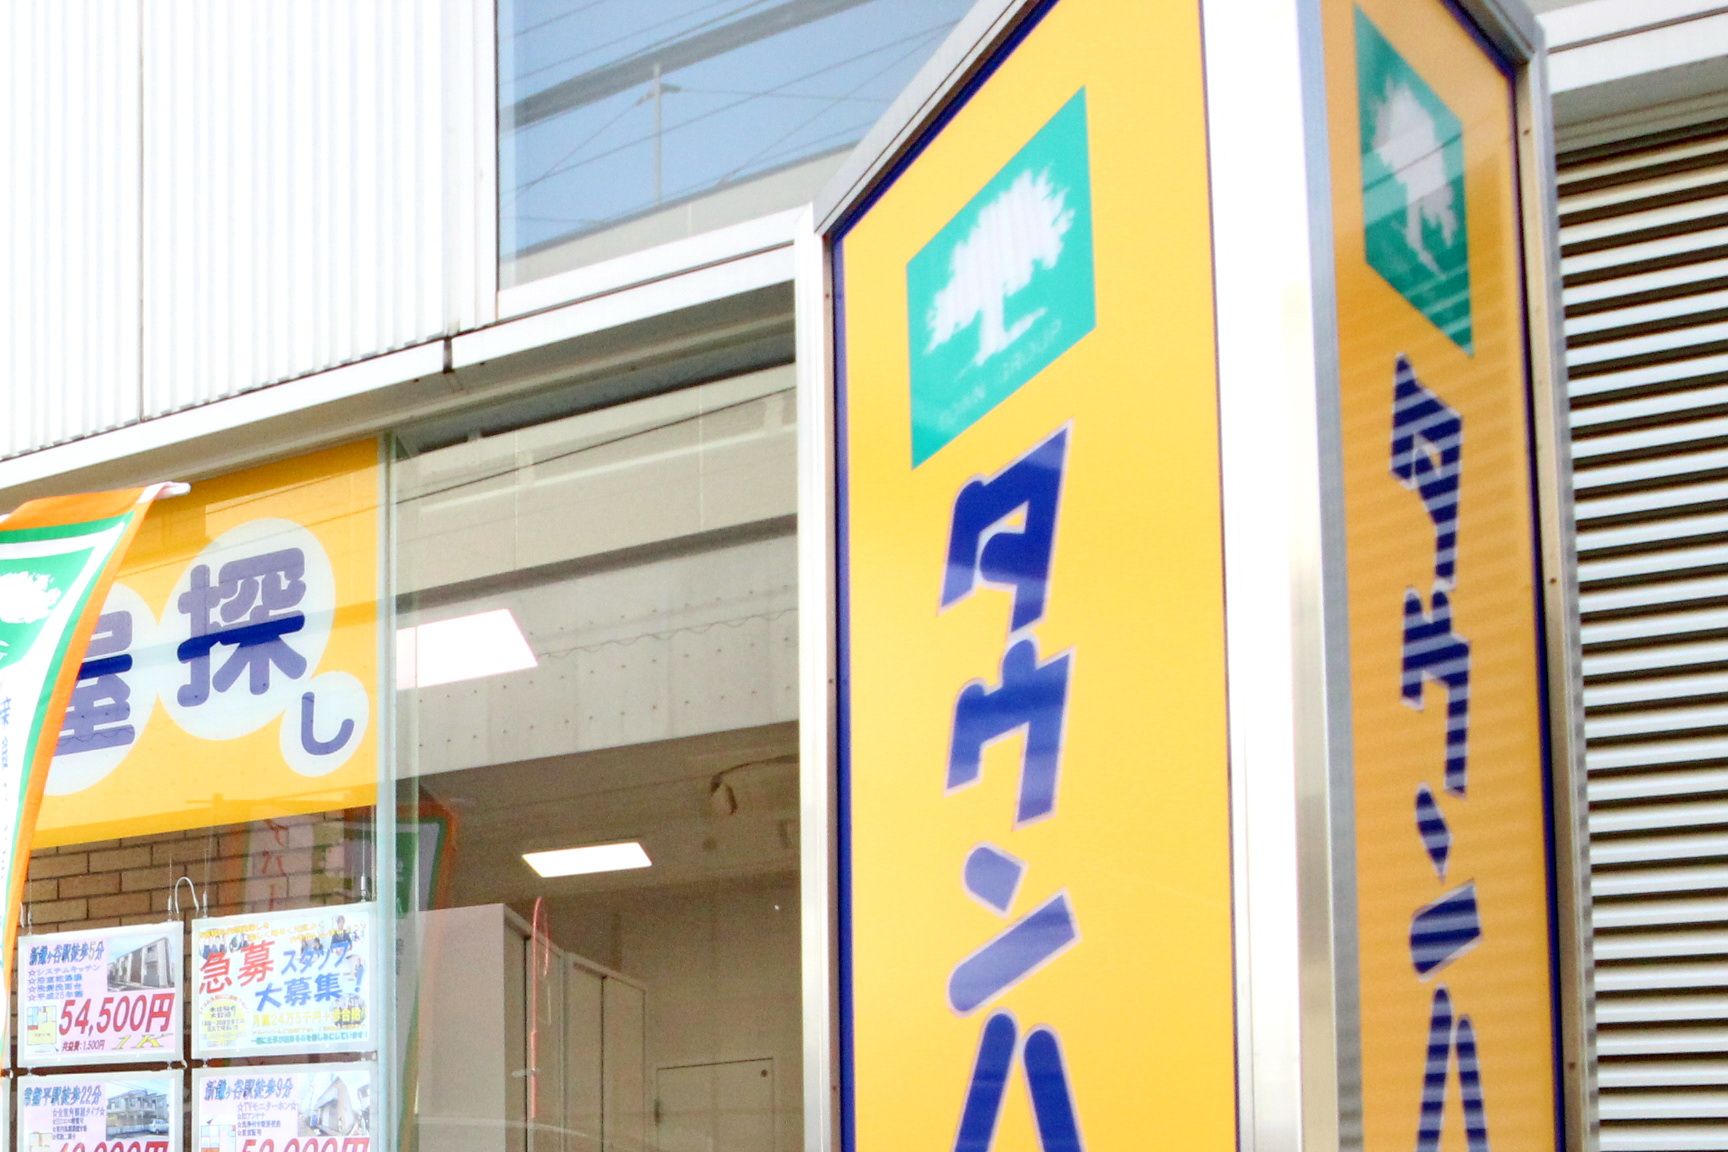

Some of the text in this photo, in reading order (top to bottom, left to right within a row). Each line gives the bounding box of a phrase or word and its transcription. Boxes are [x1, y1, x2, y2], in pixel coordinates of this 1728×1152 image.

[199, 940, 352, 995] 急募 スタッフ
[59, 993, 175, 1037] 54,500円
